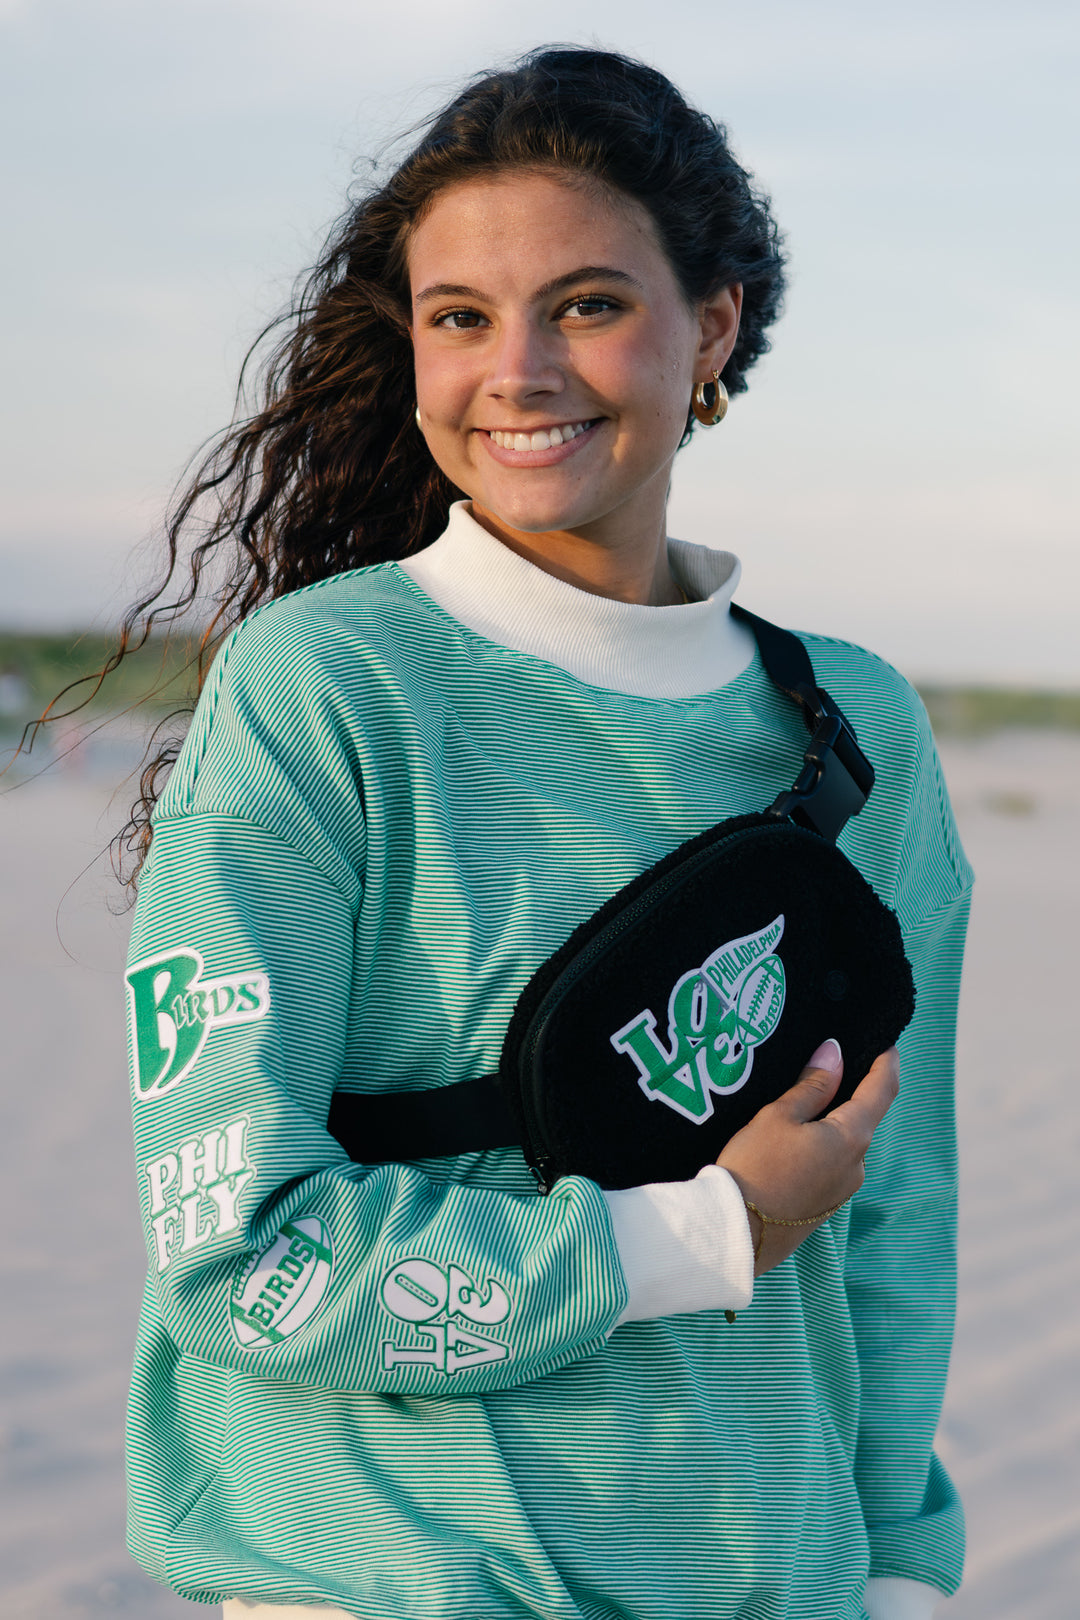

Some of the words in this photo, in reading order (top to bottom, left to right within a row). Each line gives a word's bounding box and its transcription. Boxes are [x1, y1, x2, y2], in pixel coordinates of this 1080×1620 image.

[706, 924, 780, 999] PHILADELPHIA
[758, 983, 783, 1033] BIRDS
[146, 1117, 249, 1218] PHI
[152, 1168, 256, 1275] FLY
[250, 1237, 316, 1327] BIRDS
